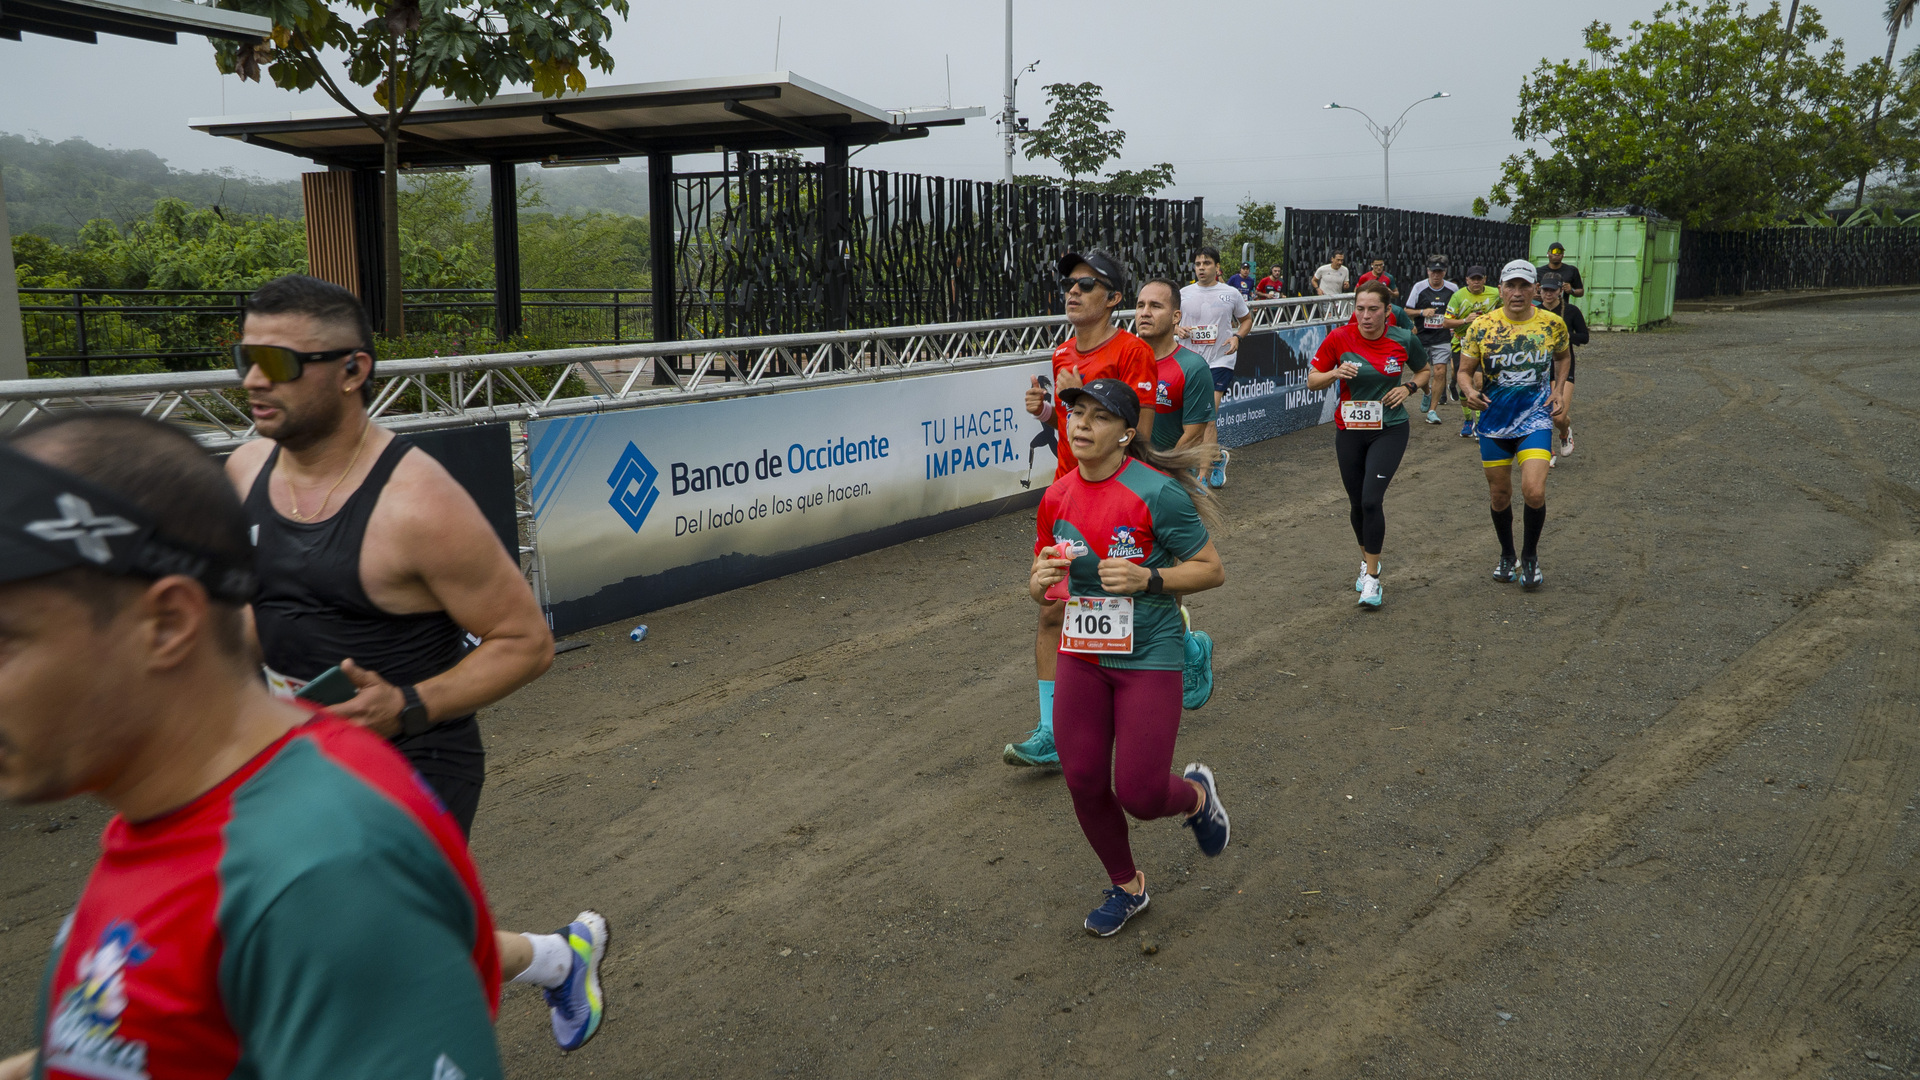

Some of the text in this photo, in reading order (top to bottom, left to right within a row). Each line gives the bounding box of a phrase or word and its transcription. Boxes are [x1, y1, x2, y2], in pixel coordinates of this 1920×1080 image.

[1196, 331, 1211, 339] 336
[1489, 349, 1548, 369] TRICALI
[1284, 370, 1295, 388] TU
[1233, 378, 1275, 401] Occidente
[1216, 413, 1225, 427] de
[1225, 412, 1235, 425] los
[1235, 412, 1247, 426] que
[1350, 410, 1371, 420] 438
[921, 407, 1018, 446] TU HACER,
[671, 434, 890, 496] Banco de Occidente
[926, 438, 1019, 480] IMPACTA.
[675, 482, 871, 537] Del lado de los que hacen.
[1075, 614, 1112, 634] 106
